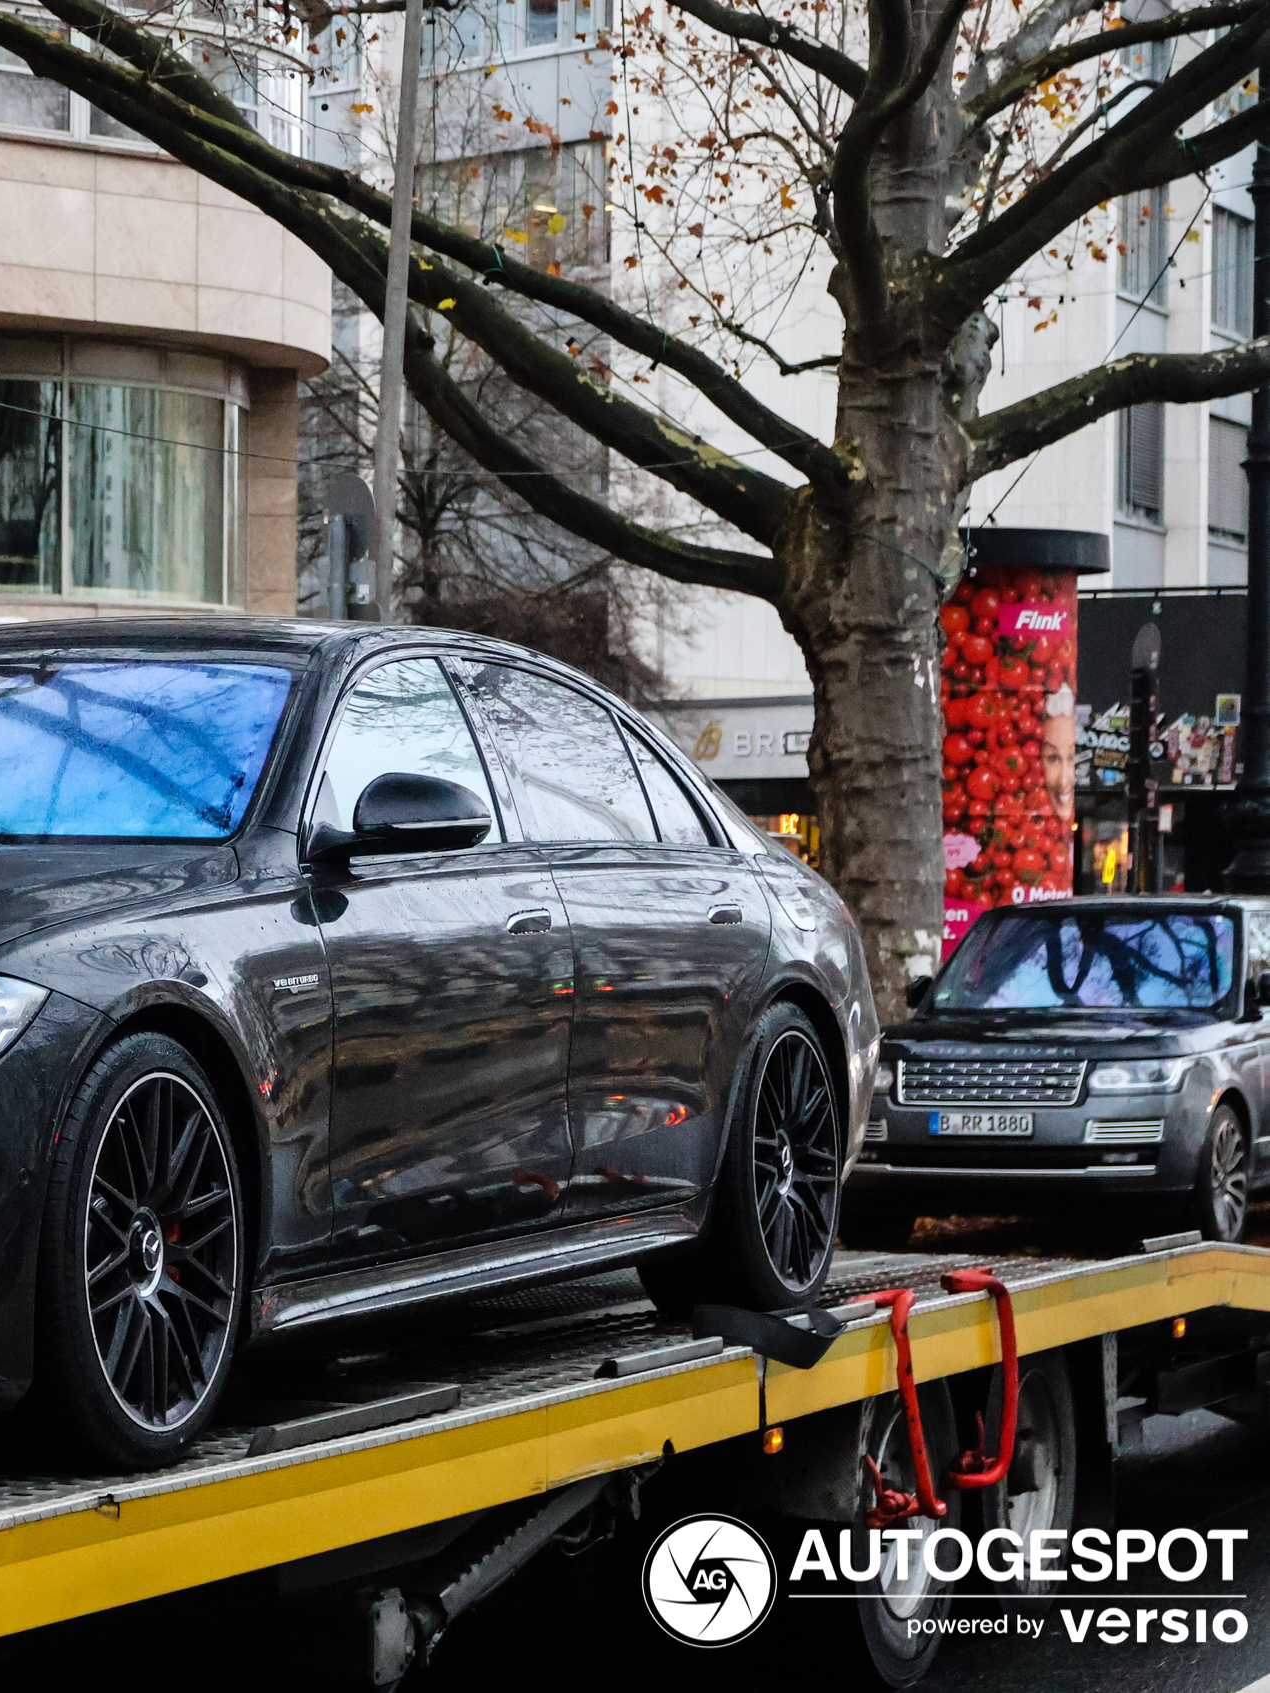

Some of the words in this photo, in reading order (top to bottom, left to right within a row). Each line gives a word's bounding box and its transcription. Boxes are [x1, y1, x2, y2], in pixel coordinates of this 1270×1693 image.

[1015, 610, 1068, 631] Flink
[944, 908, 969, 922] en
[940, 1115, 950, 1131] B
[961, 1115, 983, 1131] RR
[987, 1116, 1029, 1132] 1880
